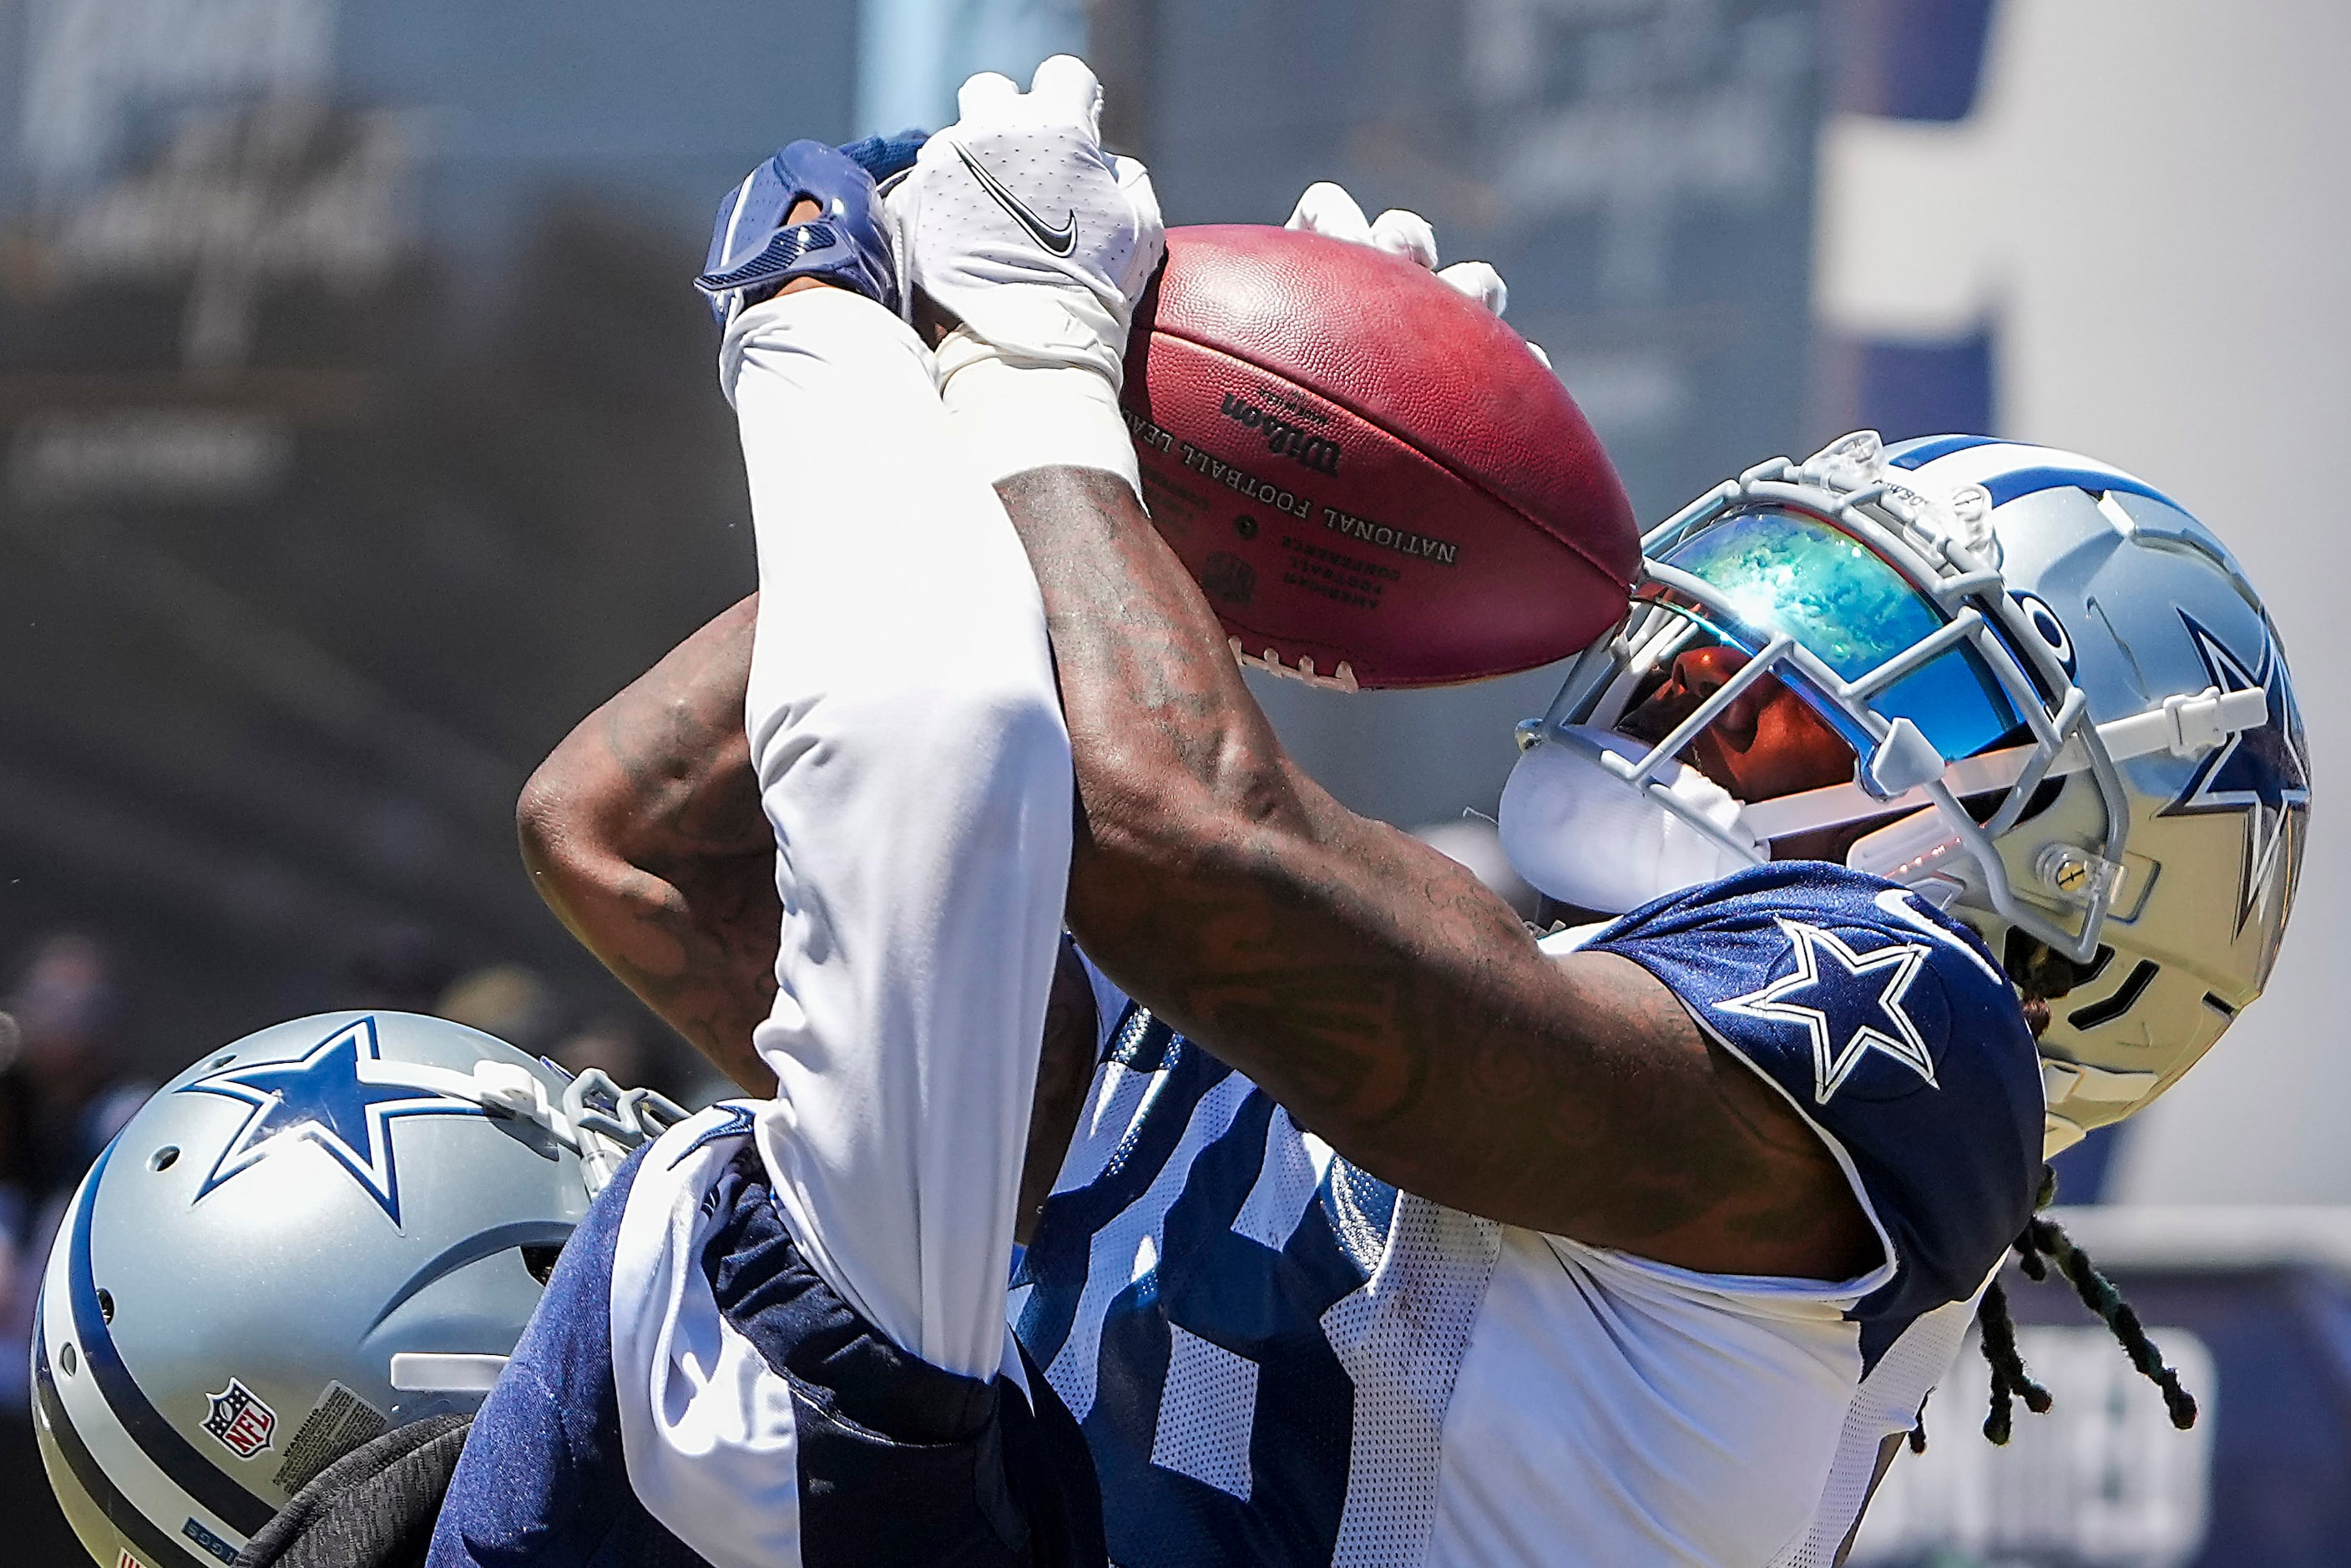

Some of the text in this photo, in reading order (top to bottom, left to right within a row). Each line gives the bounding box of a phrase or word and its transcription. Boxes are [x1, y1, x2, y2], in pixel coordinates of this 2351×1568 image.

[1221, 393, 1340, 478] Wilson
[1181, 443, 1313, 518] FOOTBALL
[1323, 508, 1457, 564] NATIONAL
[225, 1408, 270, 1453] NFL
[282, 1408, 319, 1458] WARNING
